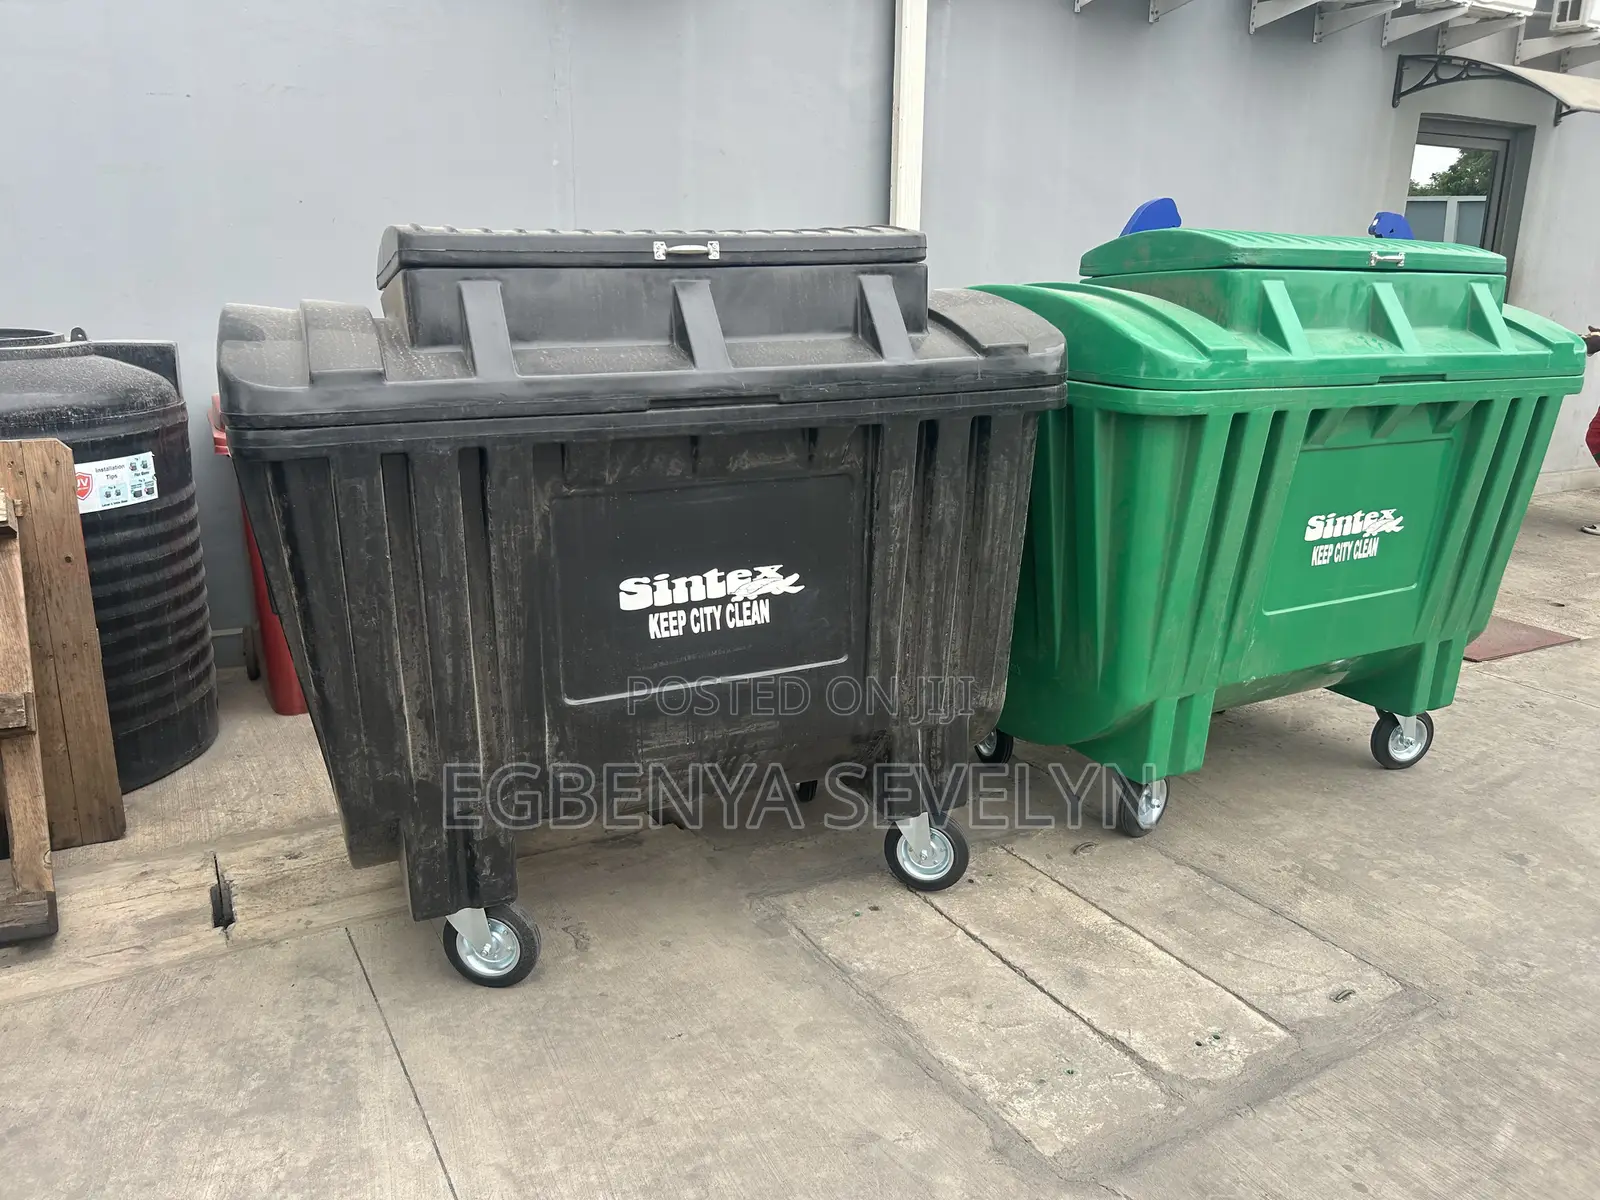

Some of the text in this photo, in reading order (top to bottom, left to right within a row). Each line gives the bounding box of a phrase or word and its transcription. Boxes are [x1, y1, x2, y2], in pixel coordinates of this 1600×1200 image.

[95, 464, 125, 473] Installation
[1304, 508, 1404, 542] Sintex
[1311, 537, 1379, 566] KEEP CITY CLEAN
[618, 564, 805, 611] Sintex
[648, 598, 770, 640] KEEP CITY CLEAN
